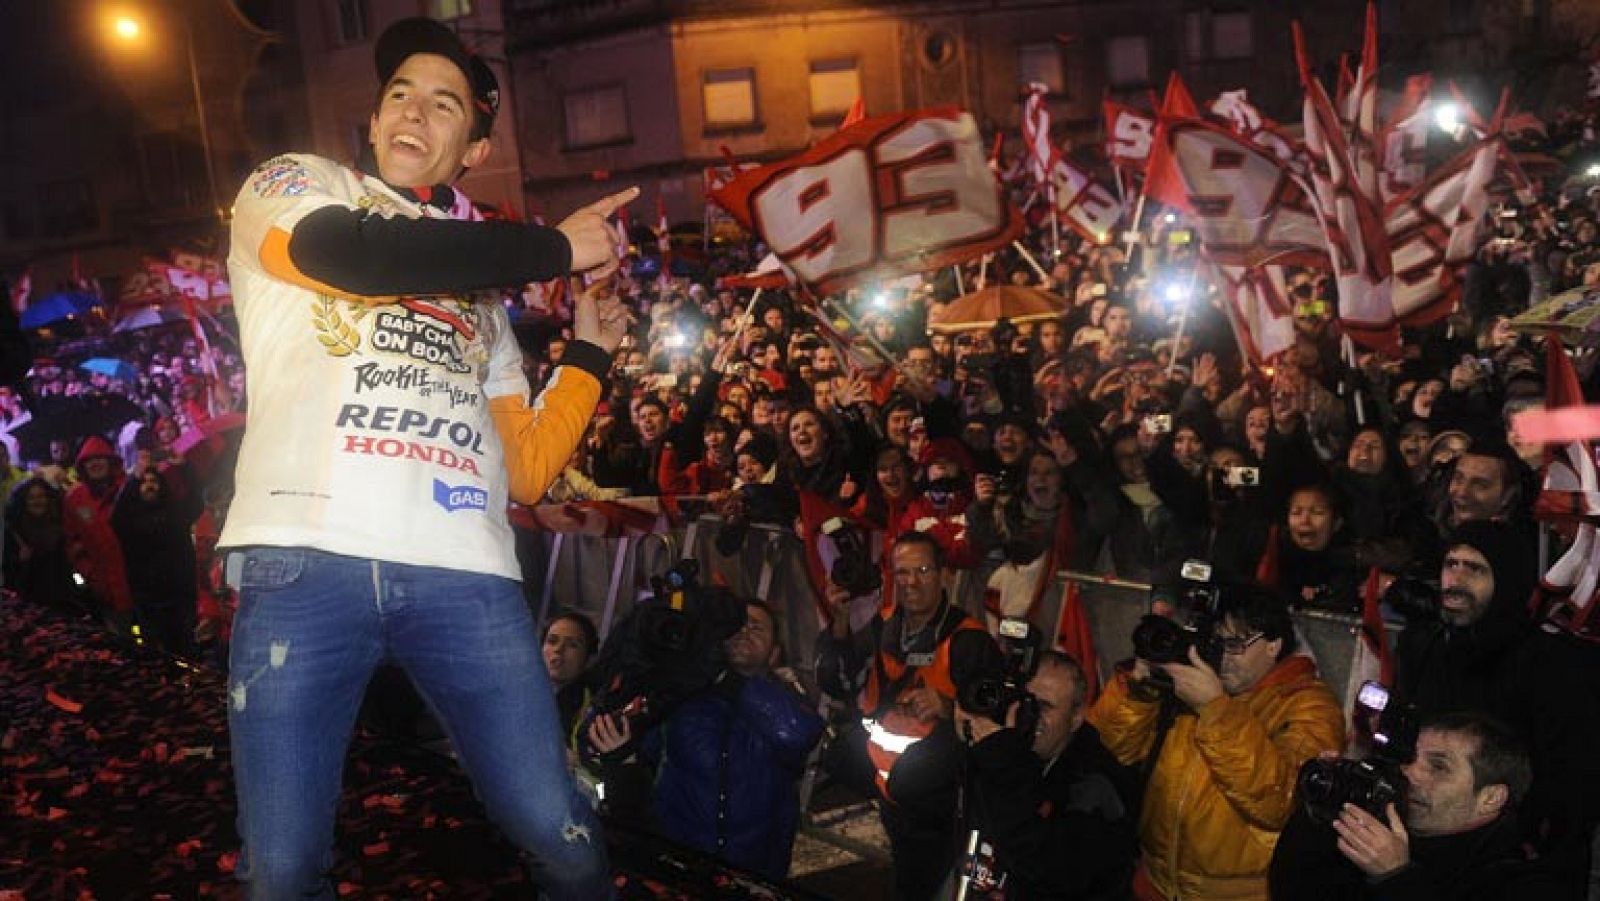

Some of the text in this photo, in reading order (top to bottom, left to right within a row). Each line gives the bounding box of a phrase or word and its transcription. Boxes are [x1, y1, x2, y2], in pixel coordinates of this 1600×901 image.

[753, 110, 1001, 284] 93
[374, 329, 408, 352] ON
[380, 314, 426, 334] BABY
[335, 403, 484, 455] REPSOL
[343, 435, 482, 477] HONDA
